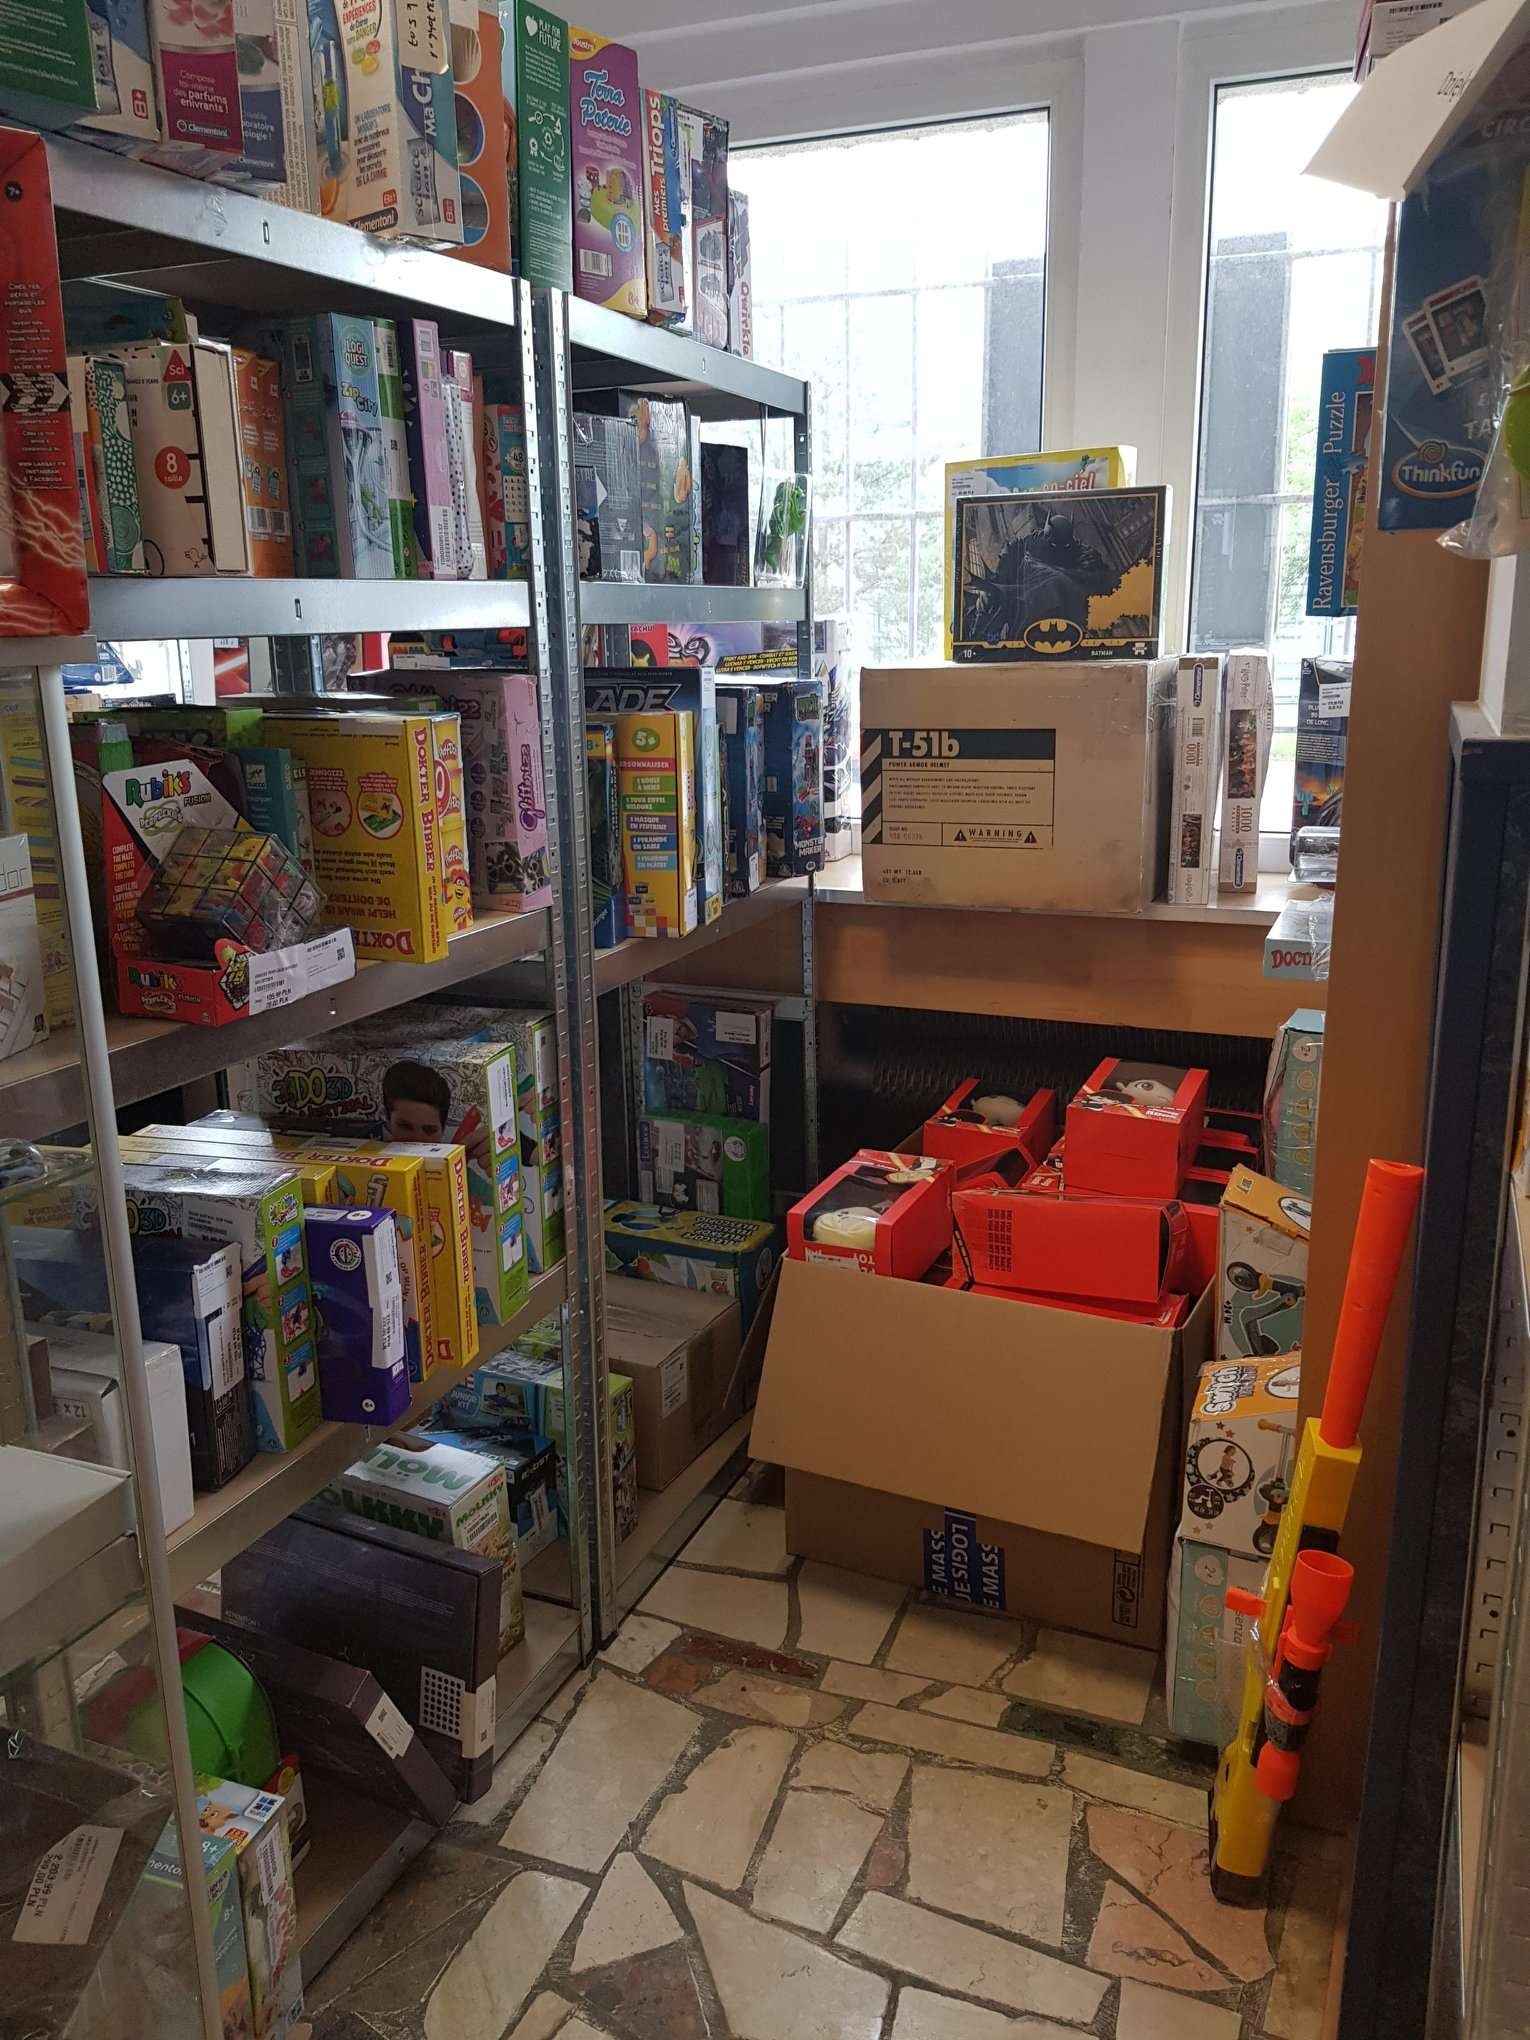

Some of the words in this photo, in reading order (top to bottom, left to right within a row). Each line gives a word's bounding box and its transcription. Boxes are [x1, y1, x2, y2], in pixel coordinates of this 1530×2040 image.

[539, 31, 561, 52] FUTURE
[180, 98, 224, 113] enivrants
[188, 90, 227, 105] parfums
[649, 96, 665, 177] Triops
[169, 364, 186, 377] Sci
[344, 352, 369, 368] QUEST
[170, 390, 188, 406] 6+
[1322, 391, 1347, 455] Puzzle
[166, 452, 178, 474] 8
[1312, 478, 1344, 609] Ravensburger
[1090, 649, 1113, 657] BATMAN
[635, 731, 656, 746] 5+
[888, 730, 960, 758] T-51b
[414, 726, 430, 804] DOKTER
[1186, 743, 1196, 766] 1000
[1240, 807, 1252, 832] 1000
[422, 808, 436, 872] BIBBER
[968, 828, 1022, 838] WARNING
[453, 1156, 466, 1235] DOKTER
[458, 1229, 470, 1286] BIBBER
[420, 1303, 434, 1370] DOKTER
[26, 1888, 40, 1907] PLN
